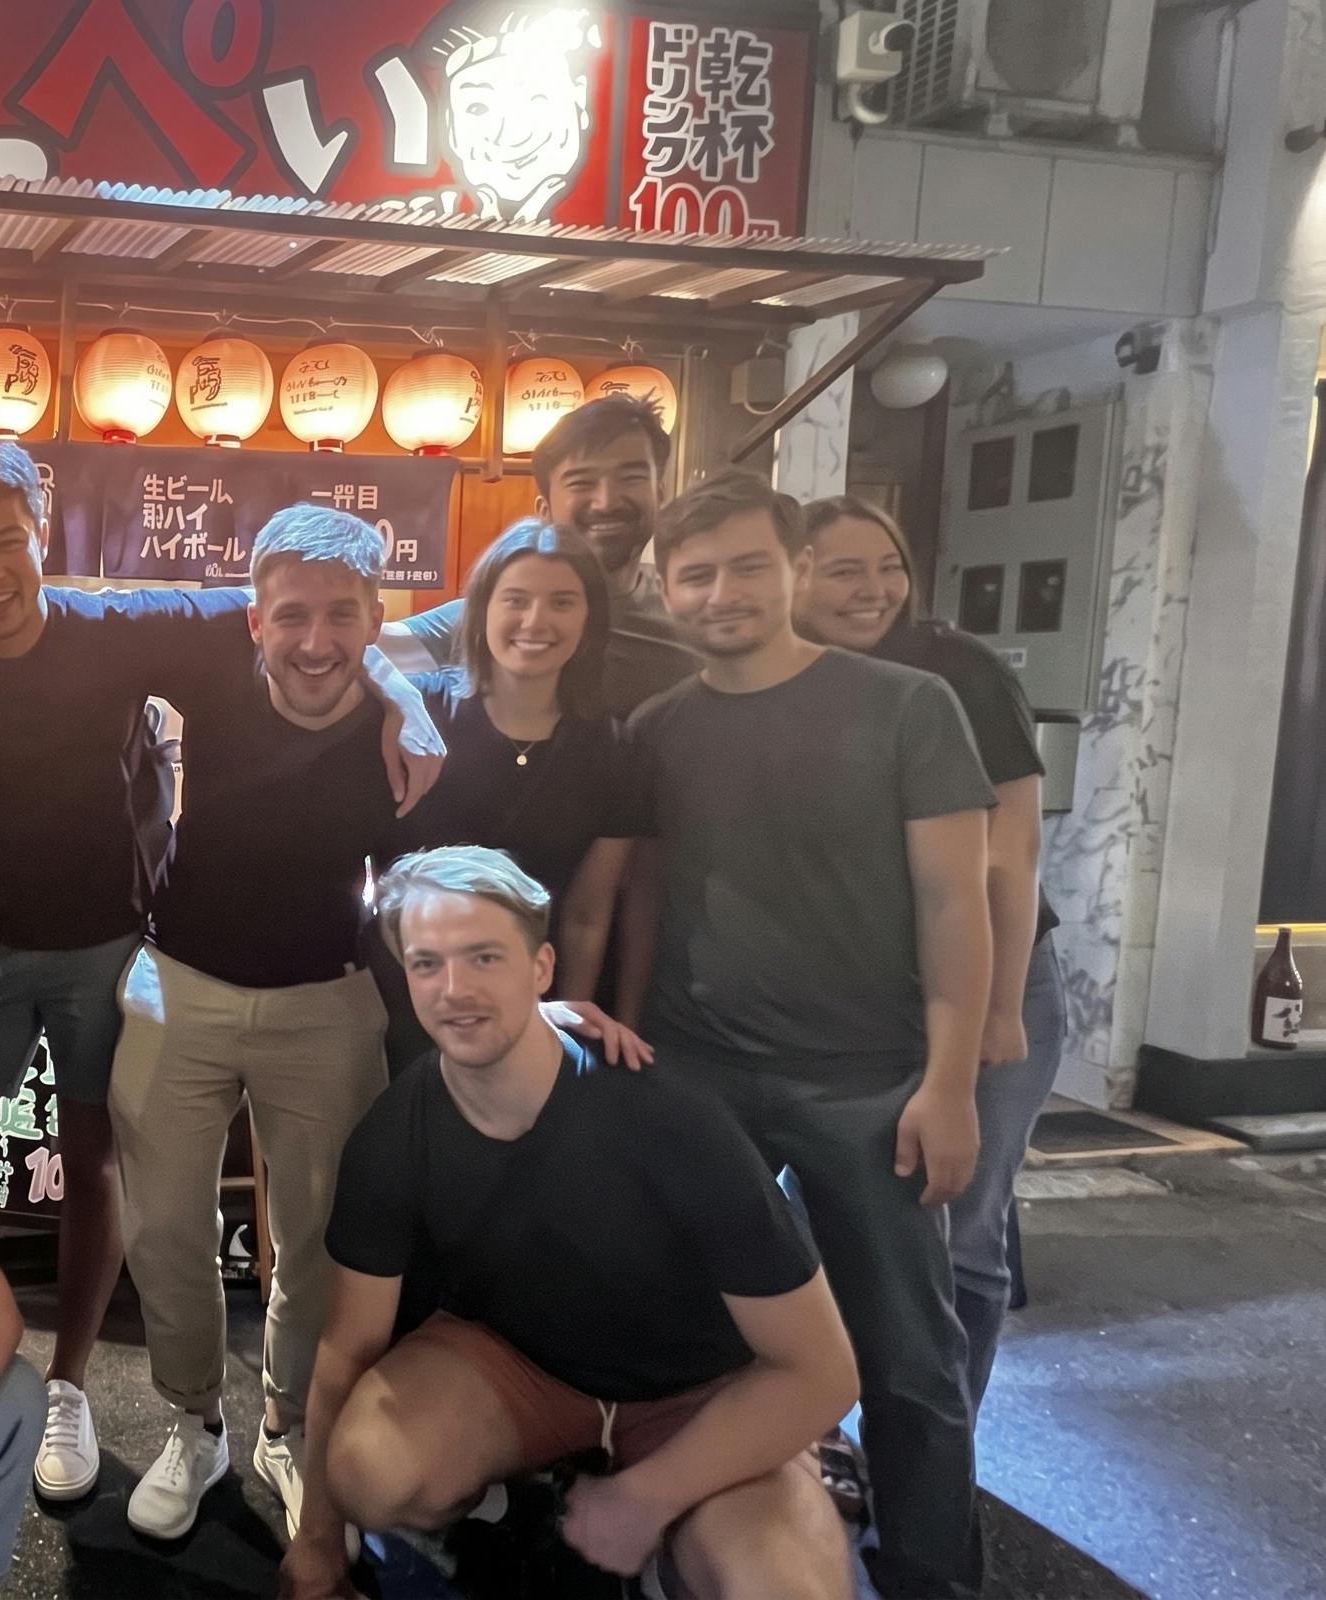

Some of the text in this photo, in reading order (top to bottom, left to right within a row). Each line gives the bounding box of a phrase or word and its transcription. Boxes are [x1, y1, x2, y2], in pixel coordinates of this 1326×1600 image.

[642, 21, 698, 177] ドリンク
[688, 28, 775, 182] 乾杯
[140, 532, 247, 562] ハイボール
